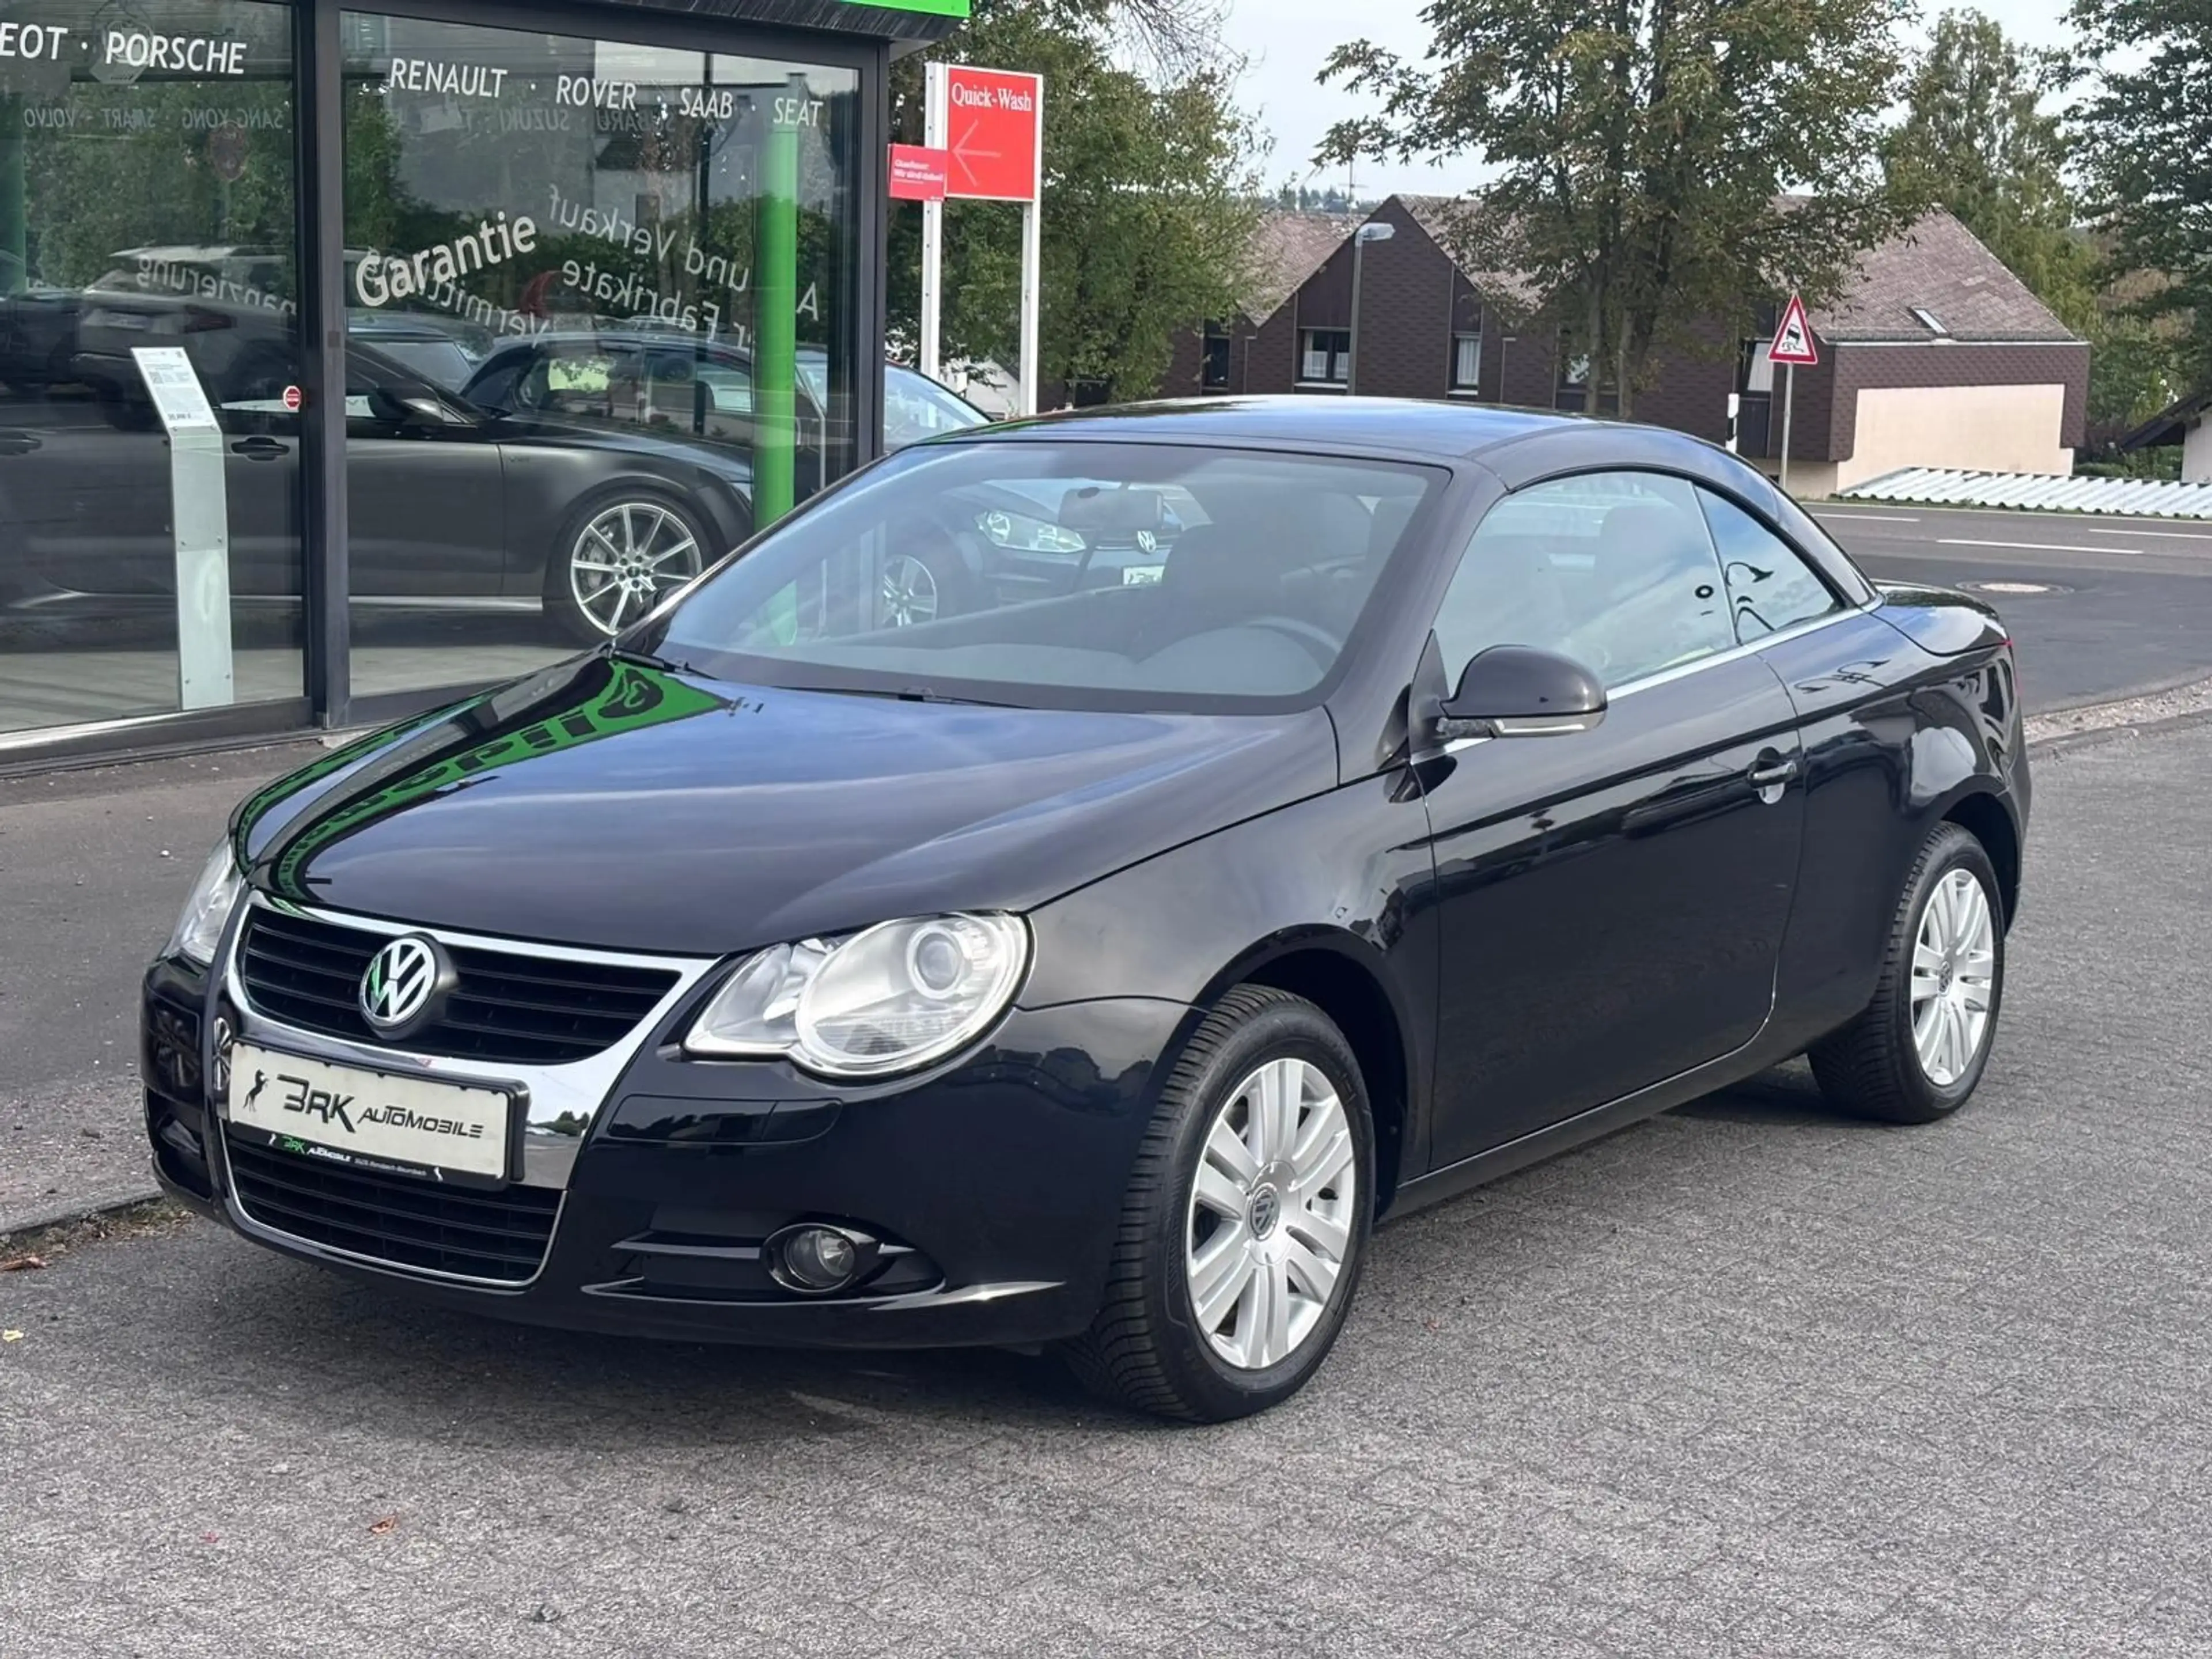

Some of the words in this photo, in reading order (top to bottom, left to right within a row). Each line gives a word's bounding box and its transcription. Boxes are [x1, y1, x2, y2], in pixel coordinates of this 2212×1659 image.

[106, 31, 247, 74] PORSCHE
[390, 57, 509, 98] RENAULT
[556, 75, 637, 111] ROVER
[679, 87, 733, 119] SAAB
[773, 97, 824, 127] SEAT
[951, 82, 1032, 111] Quick-Wash
[355, 211, 536, 306] Garantie
[276, 1073, 356, 1134] BRK
[357, 1105, 484, 1139] AUTOMOBILE
